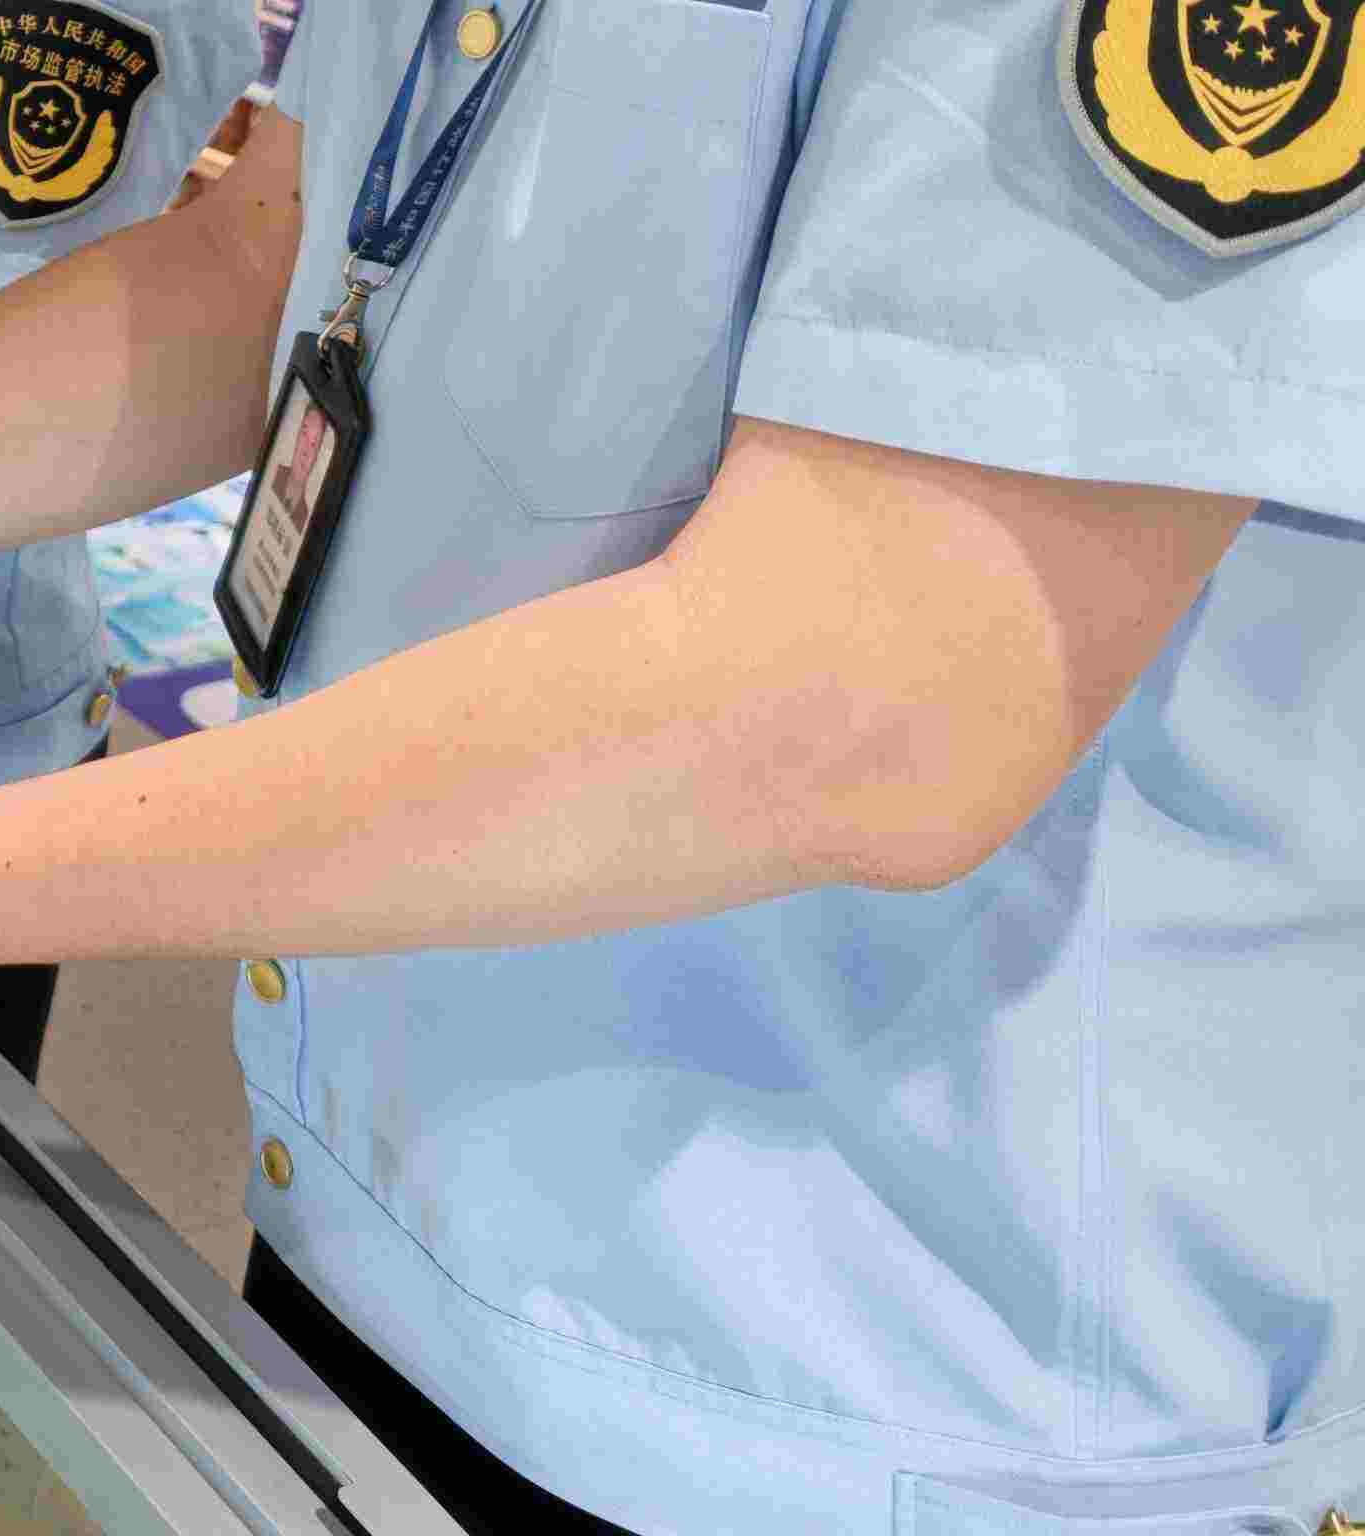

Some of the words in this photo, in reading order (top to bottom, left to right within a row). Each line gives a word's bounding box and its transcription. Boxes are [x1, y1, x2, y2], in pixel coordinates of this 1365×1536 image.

[0, 38, 128, 96] 市场监管执法
